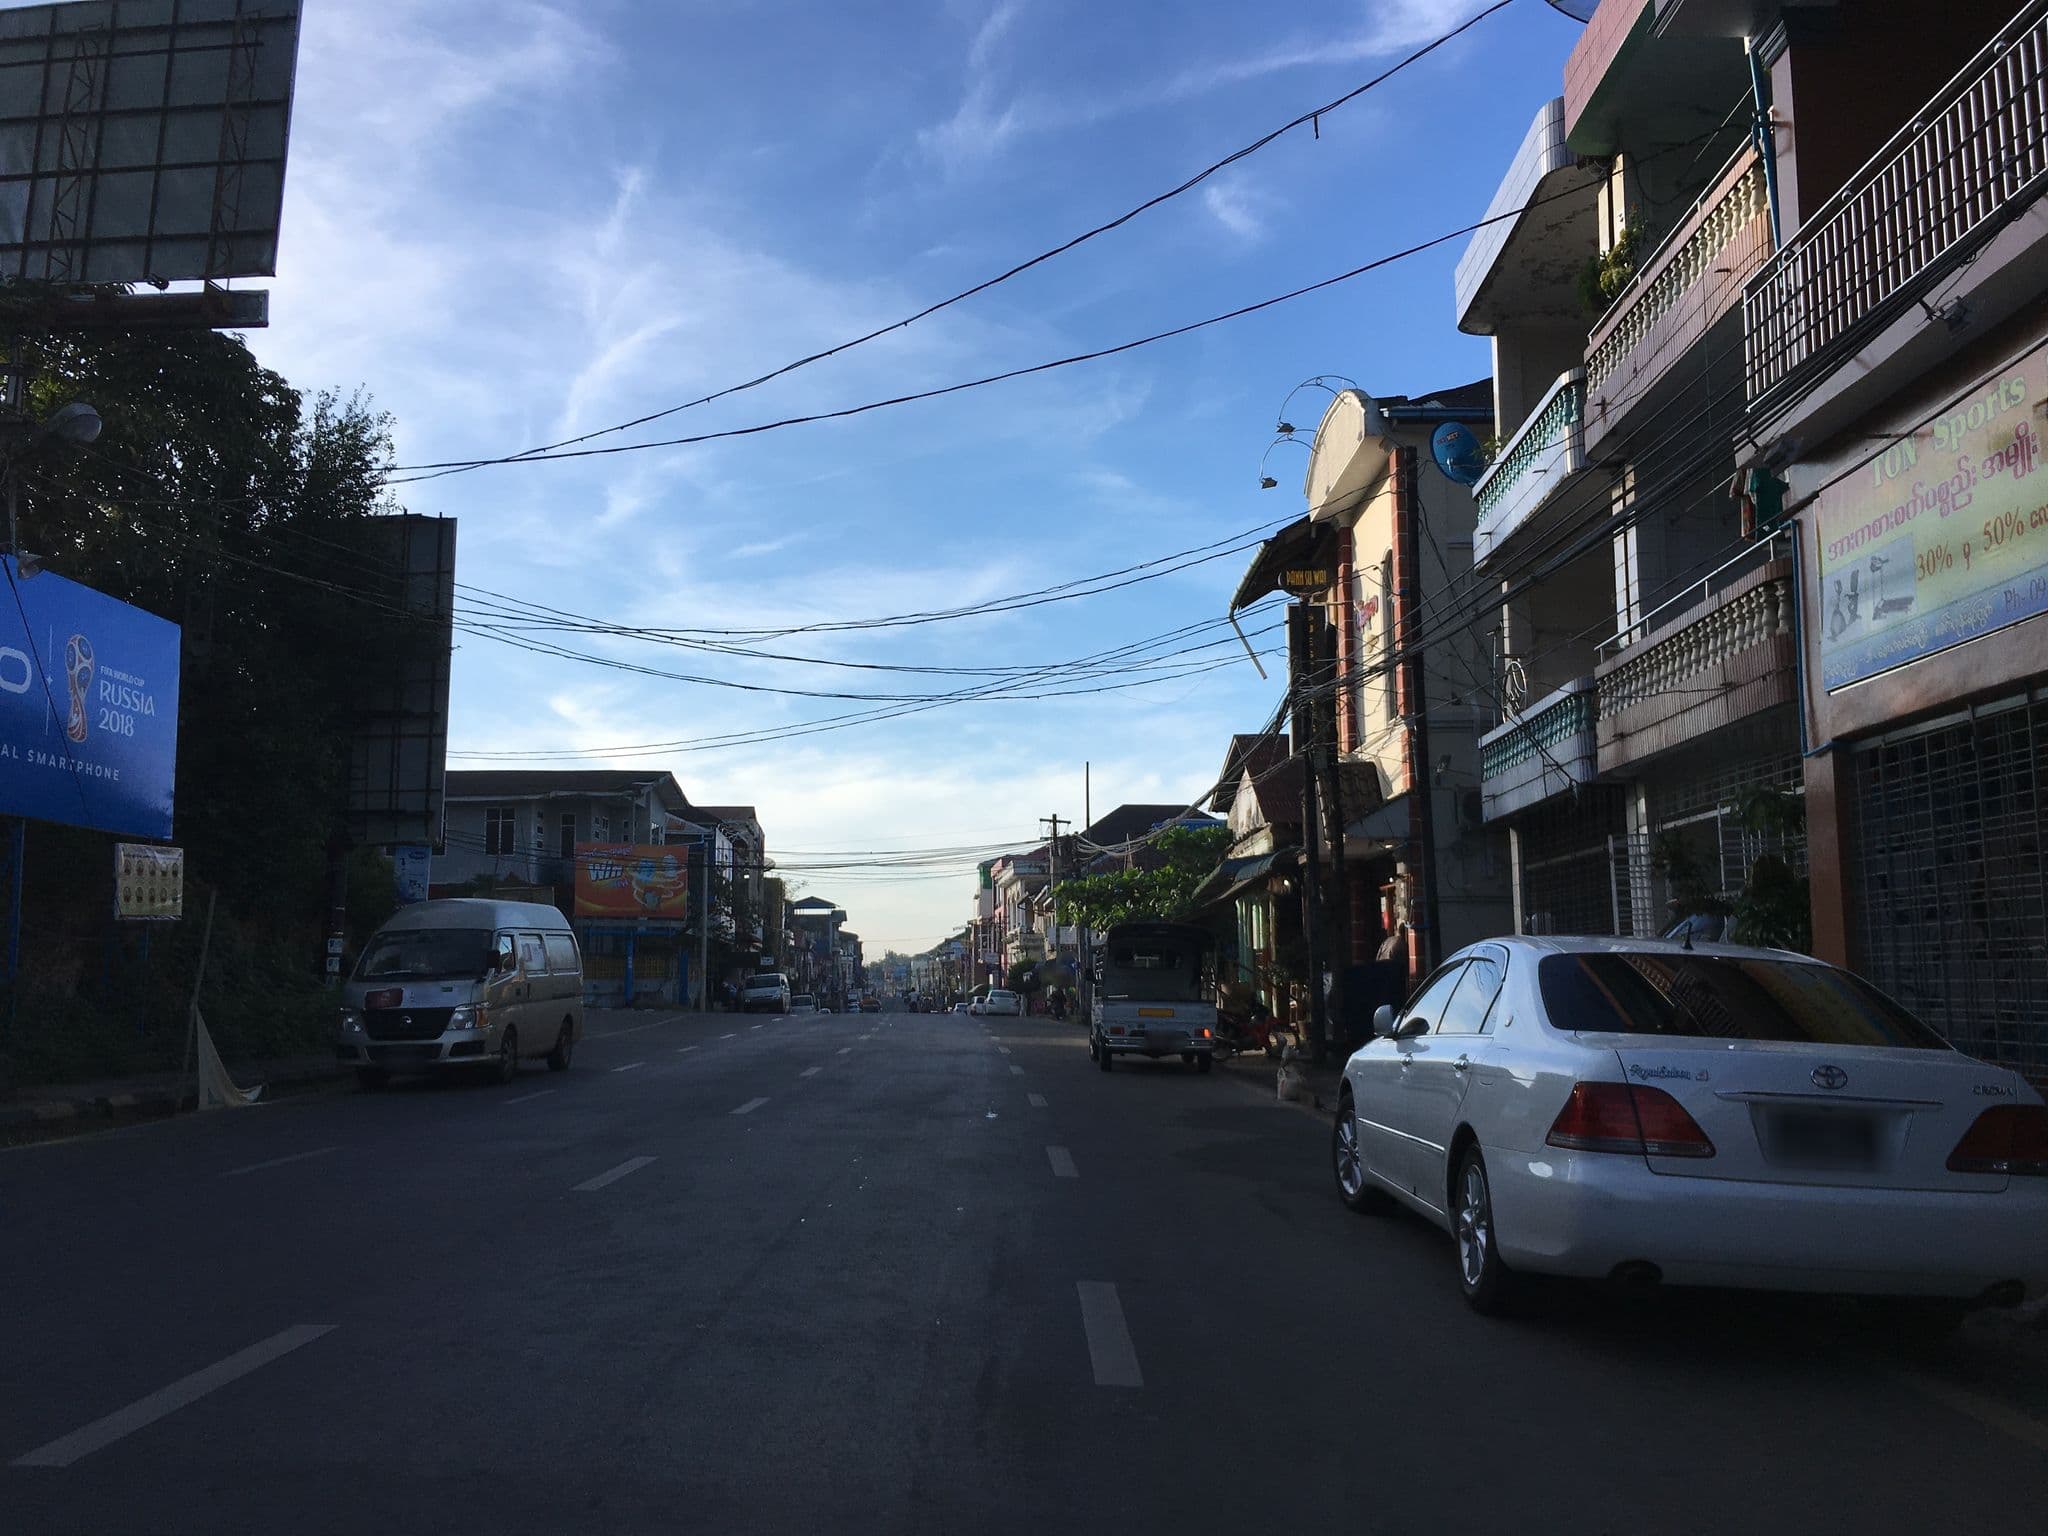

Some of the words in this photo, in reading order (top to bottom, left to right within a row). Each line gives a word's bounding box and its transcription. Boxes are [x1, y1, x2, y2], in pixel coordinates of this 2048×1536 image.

[1932, 376, 2027, 454] Sports
[1917, 542, 1953, 582] 30%
[1983, 505, 2025, 552] 50%
[98, 707, 135, 737] 2018
[100, 679, 155, 717] RUSSIA
